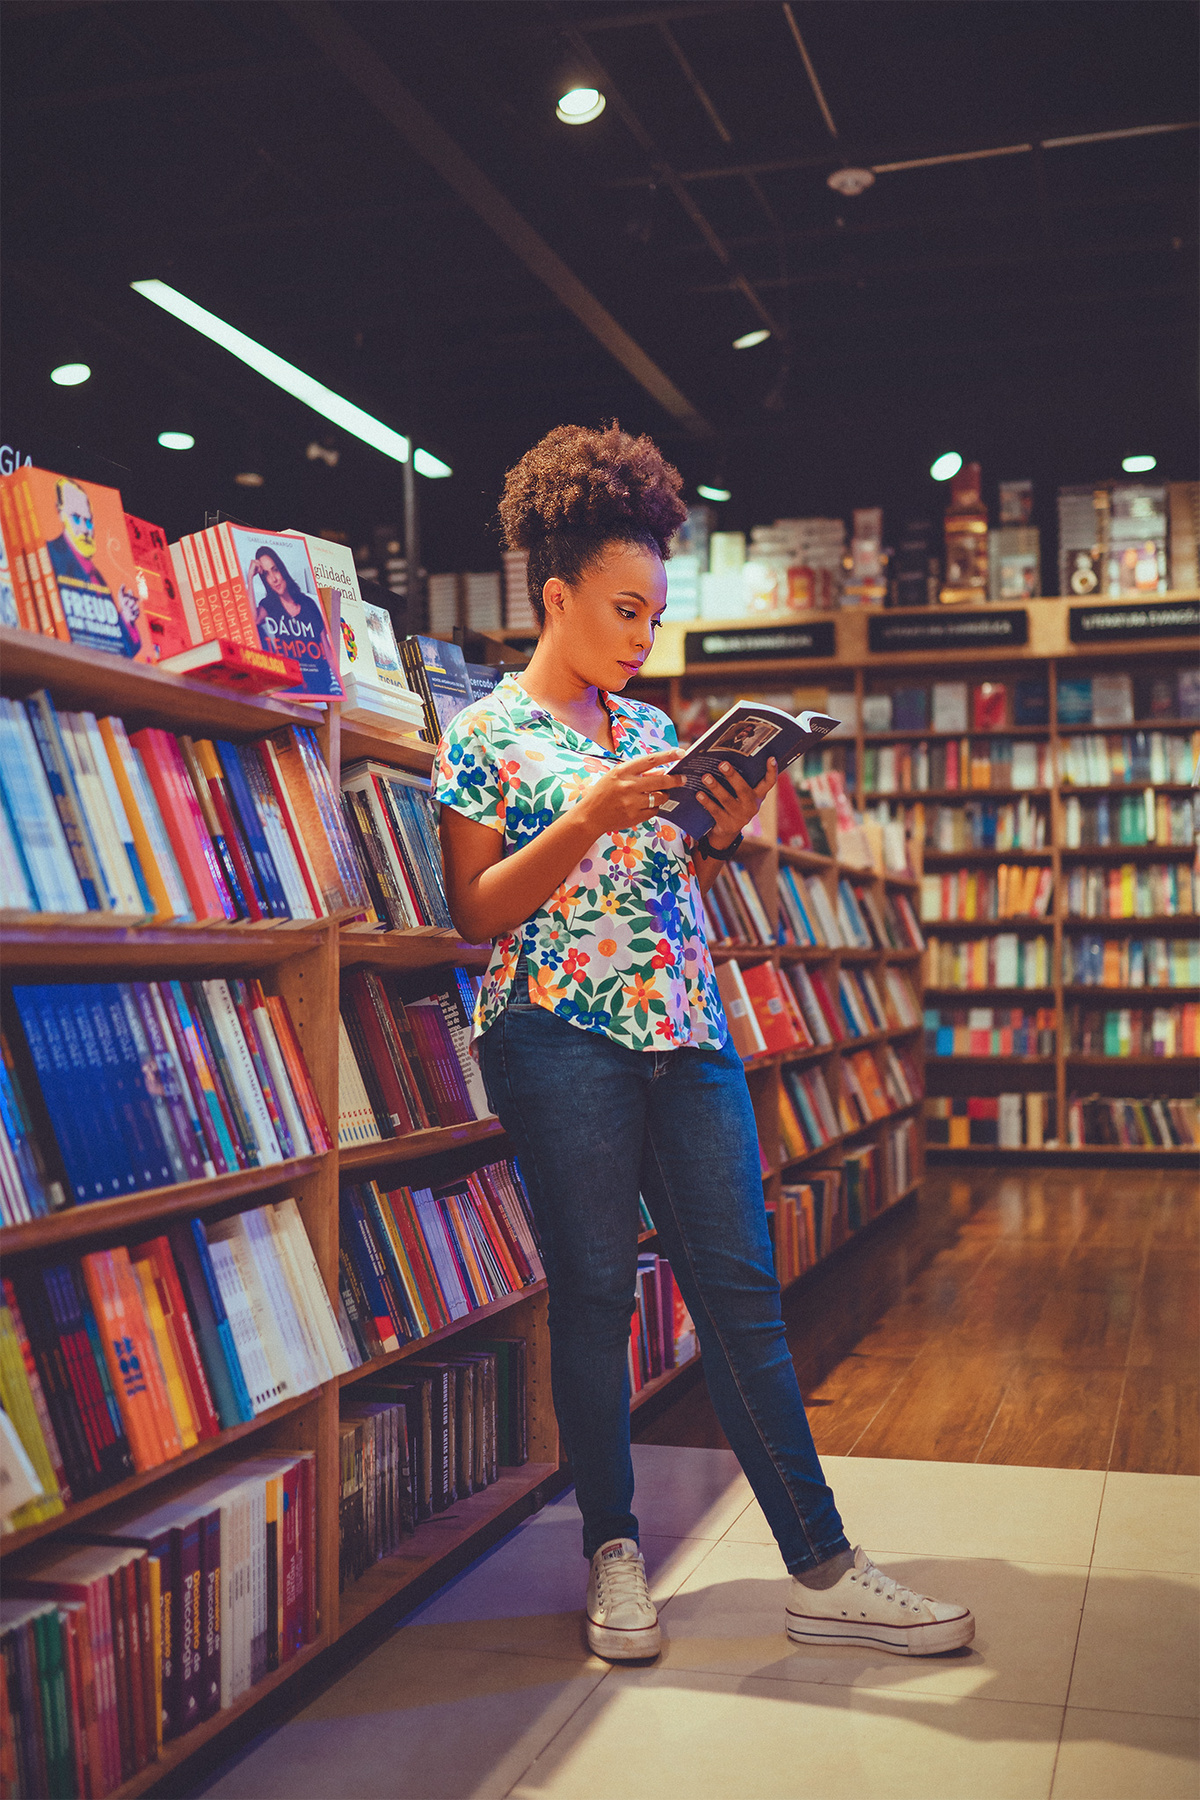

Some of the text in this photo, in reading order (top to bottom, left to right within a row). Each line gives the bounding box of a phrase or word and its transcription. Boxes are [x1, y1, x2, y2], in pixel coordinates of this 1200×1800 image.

[61, 588, 119, 625] FREUD
[225, 608, 237, 628] UM
[237, 603, 249, 623] UM
[200, 616, 212, 636] UM
[212, 613, 224, 632] UM
[265, 615, 315, 638] DÁ UM
[264, 636, 327, 660] TEMPO!
[193, 1570, 201, 1672] Dicionário de
[206, 1572, 215, 1657] Psicologia
[164, 1591, 172, 1678] Dicionário de
[182, 1574, 193, 1680] Psicologia
